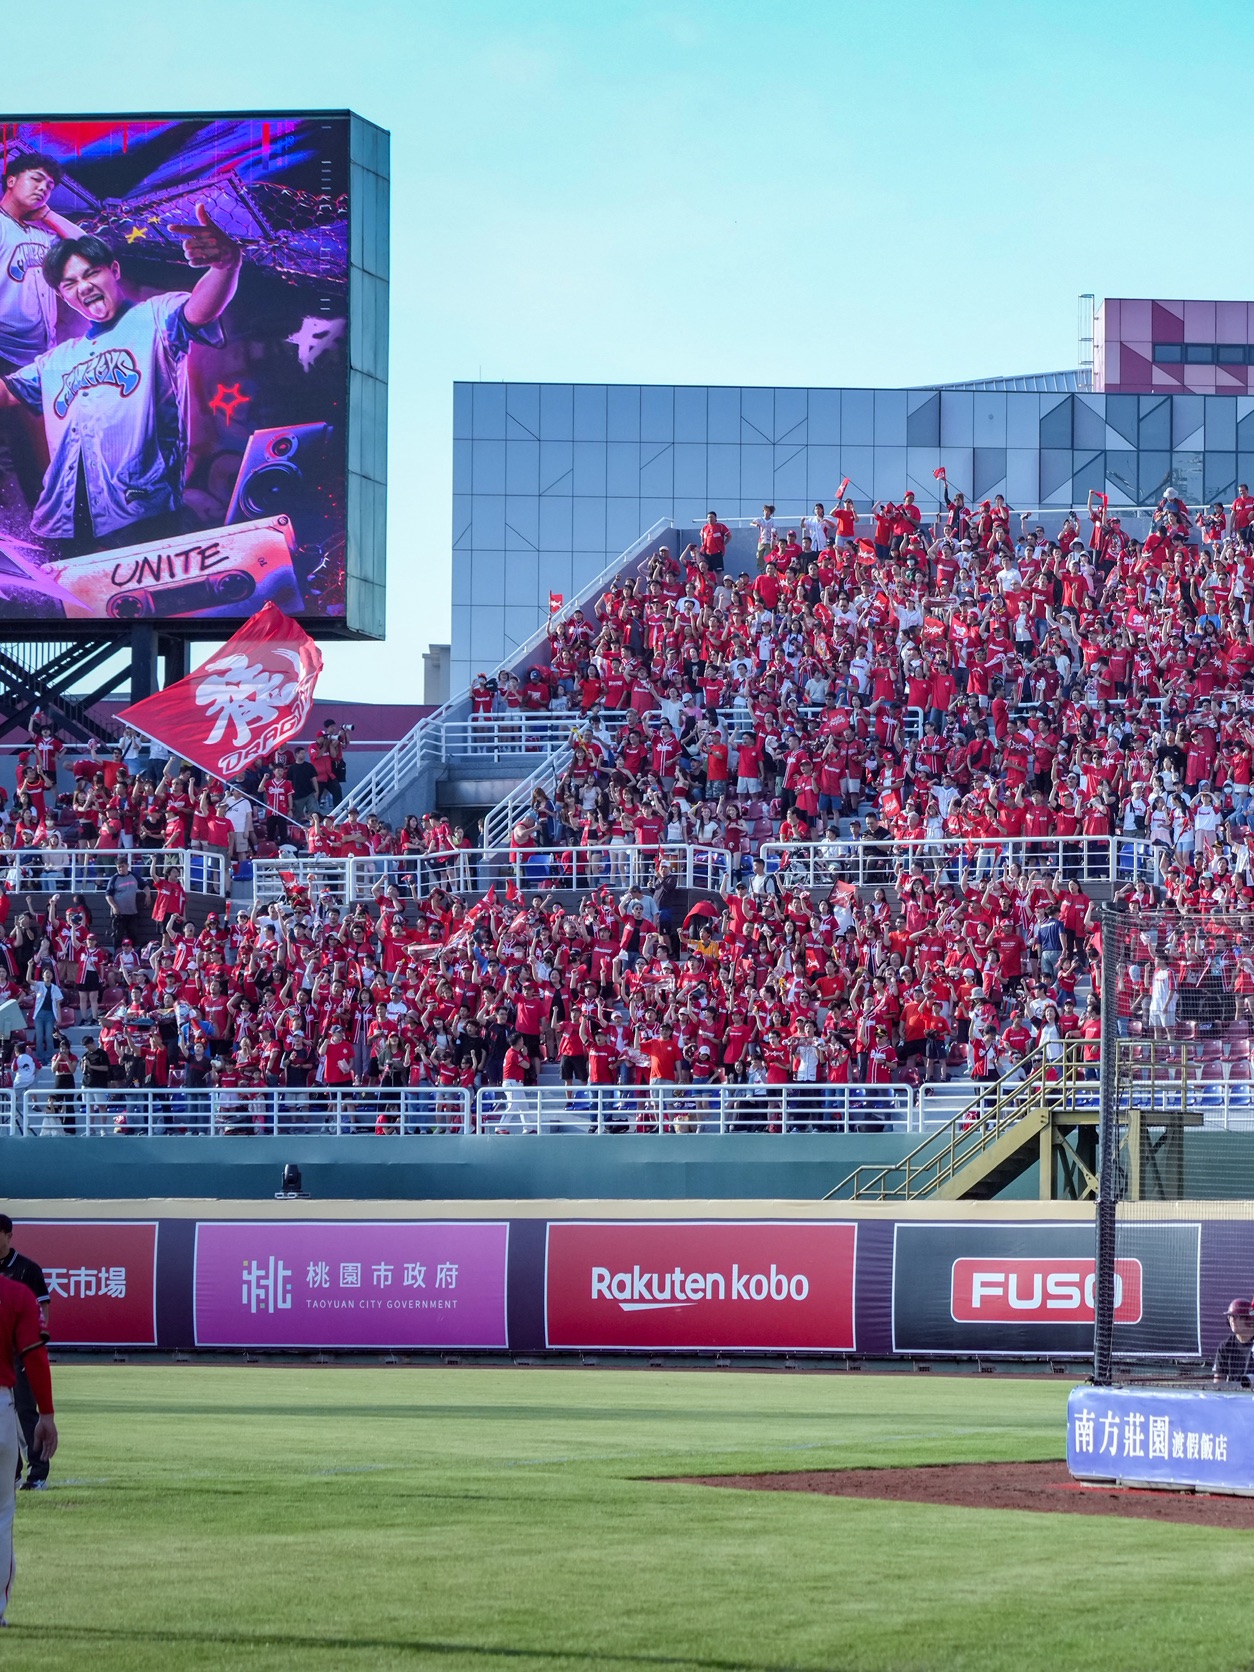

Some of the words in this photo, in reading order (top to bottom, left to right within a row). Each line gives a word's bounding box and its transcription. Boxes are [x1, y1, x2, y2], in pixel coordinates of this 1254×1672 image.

[111, 542, 230, 587] UNITE
[42, 1266, 126, 1299] 天市場
[306, 1261, 459, 1289] 桃園市政府
[591, 1265, 725, 1300] Rakuten
[731, 1264, 809, 1301] kobo
[971, 1273, 1123, 1310] FUSO
[306, 1300, 355, 1309] TAOYUAN
[359, 1300, 382, 1309] CITY
[386, 1300, 458, 1309] GOVERNMENT
